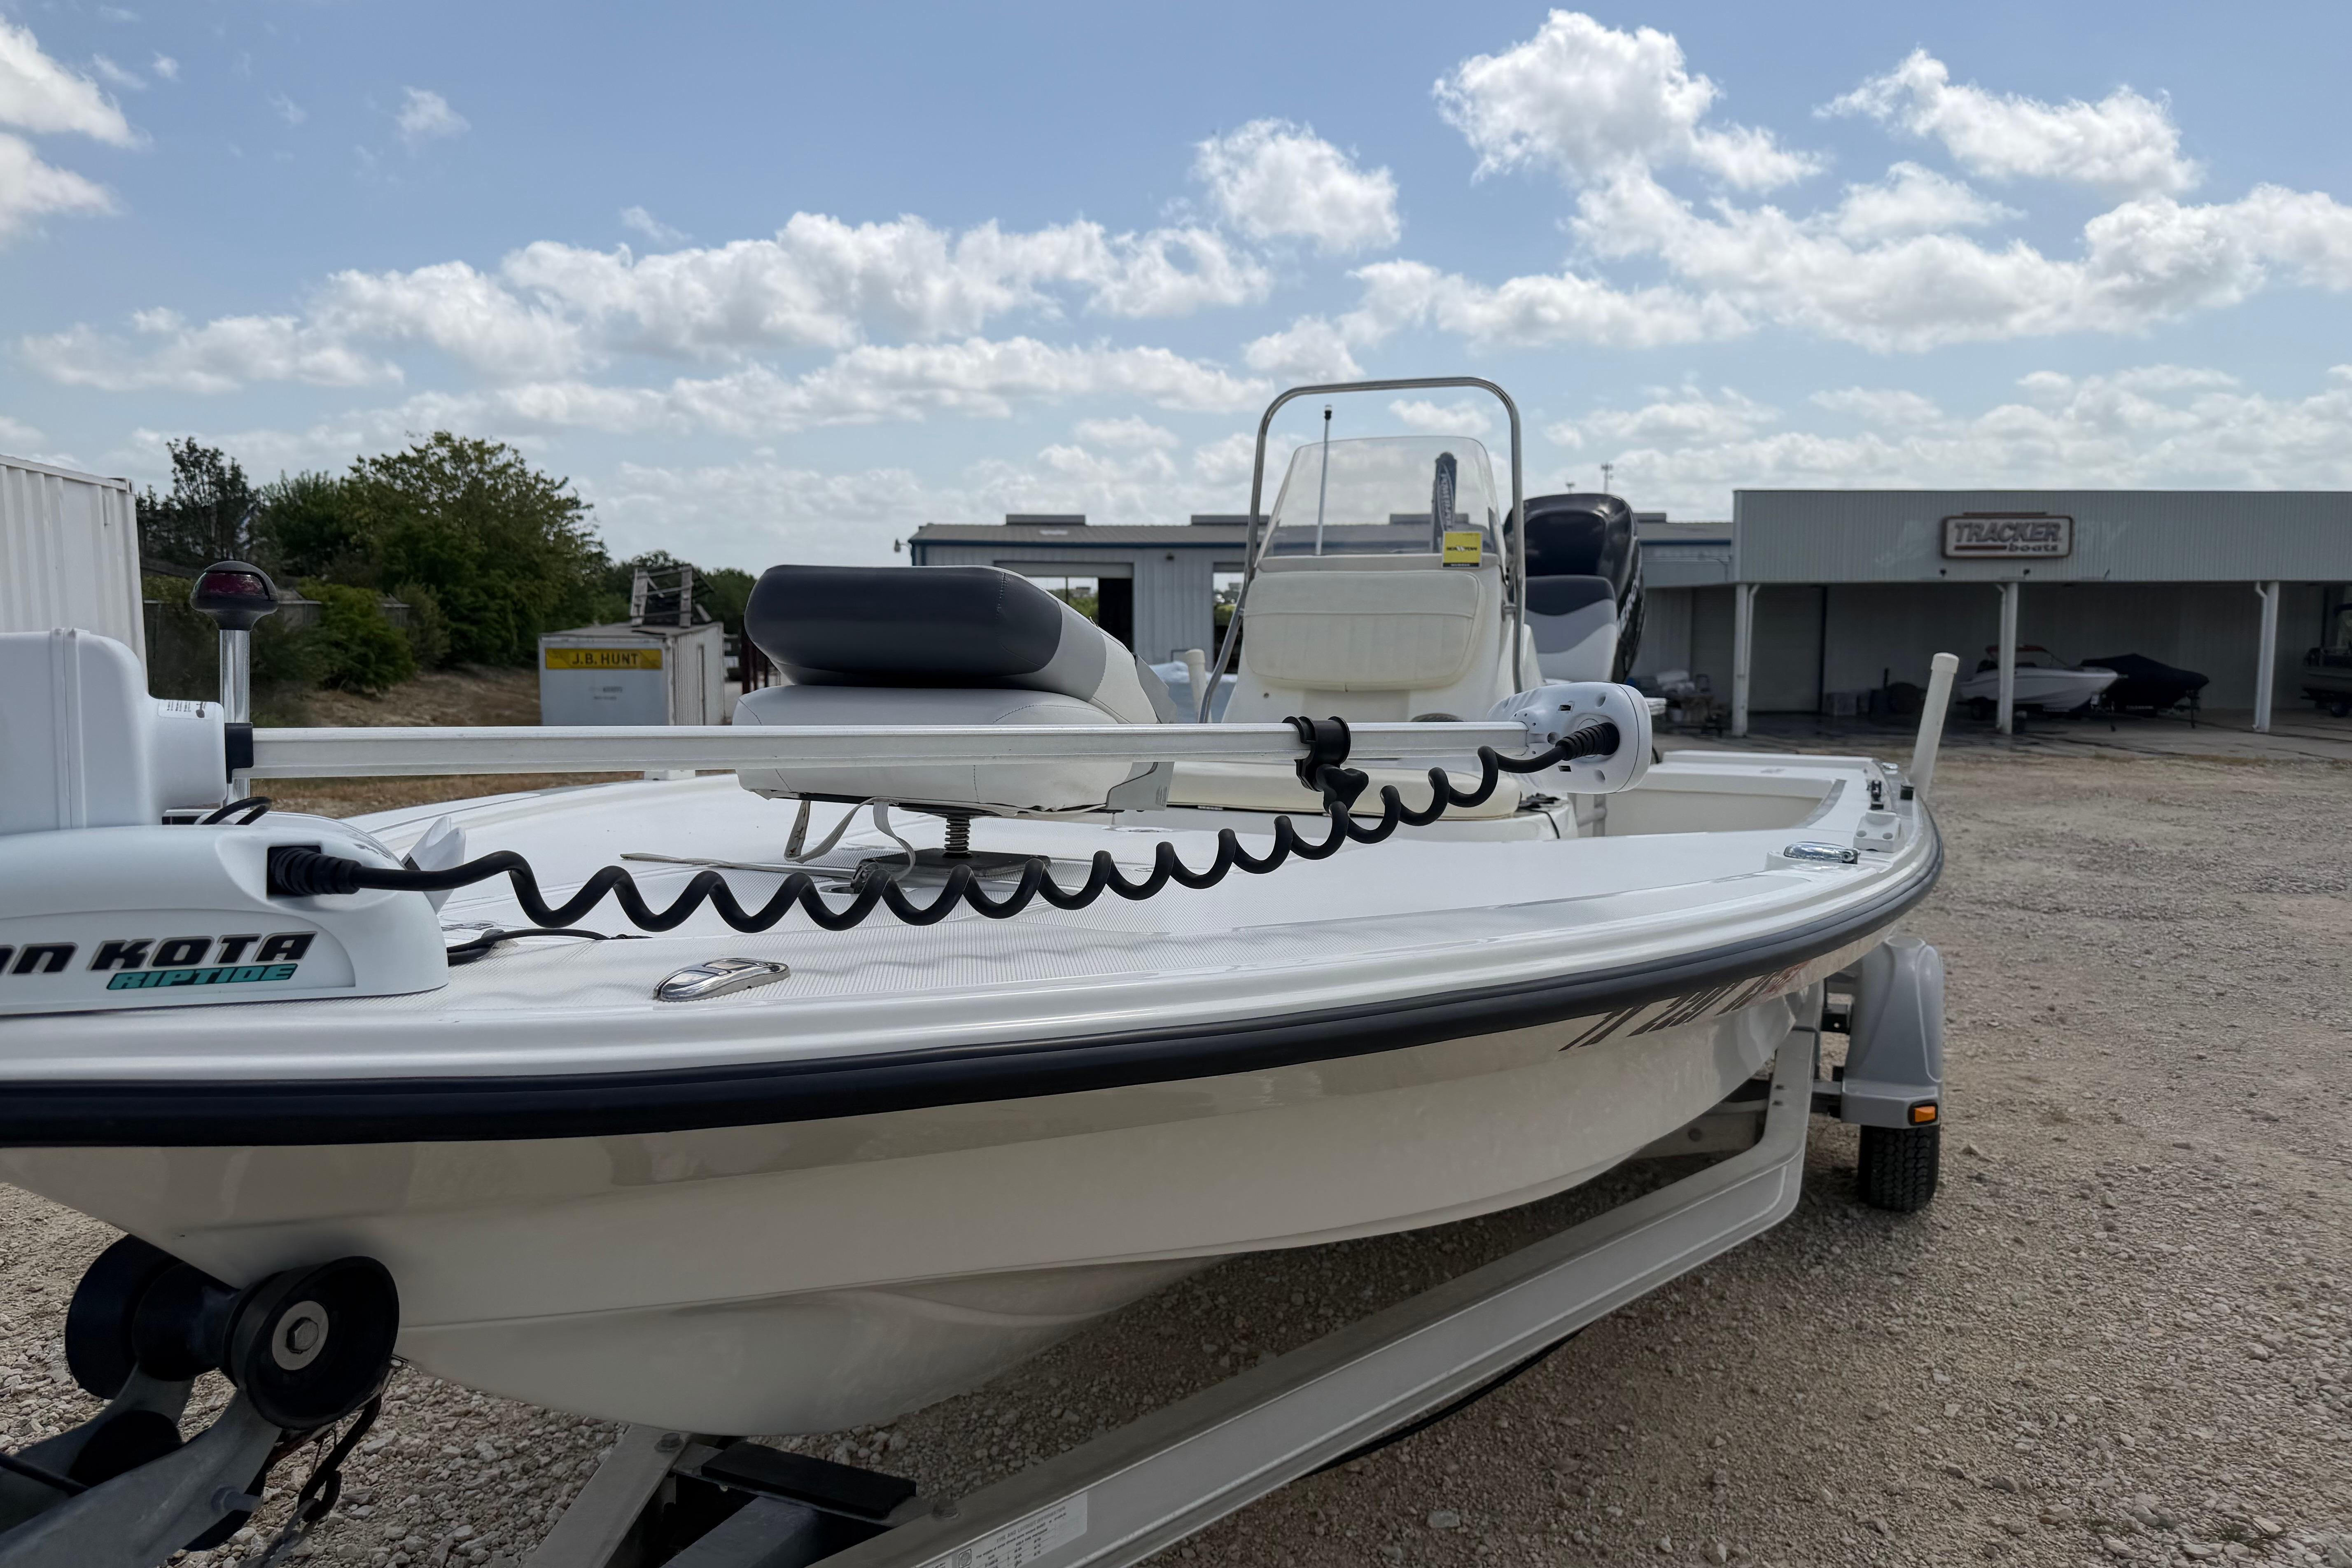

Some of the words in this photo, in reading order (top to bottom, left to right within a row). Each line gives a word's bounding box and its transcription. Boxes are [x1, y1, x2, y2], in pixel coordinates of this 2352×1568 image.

[1954, 522, 2061, 542] TRACKER
[2009, 542, 2058, 552] boats
[572, 653, 597, 665] J.B.
[601, 652, 638, 665] HUNT
[87, 931, 317, 971] KOTA
[108, 964, 297, 989] RIPTIDE
